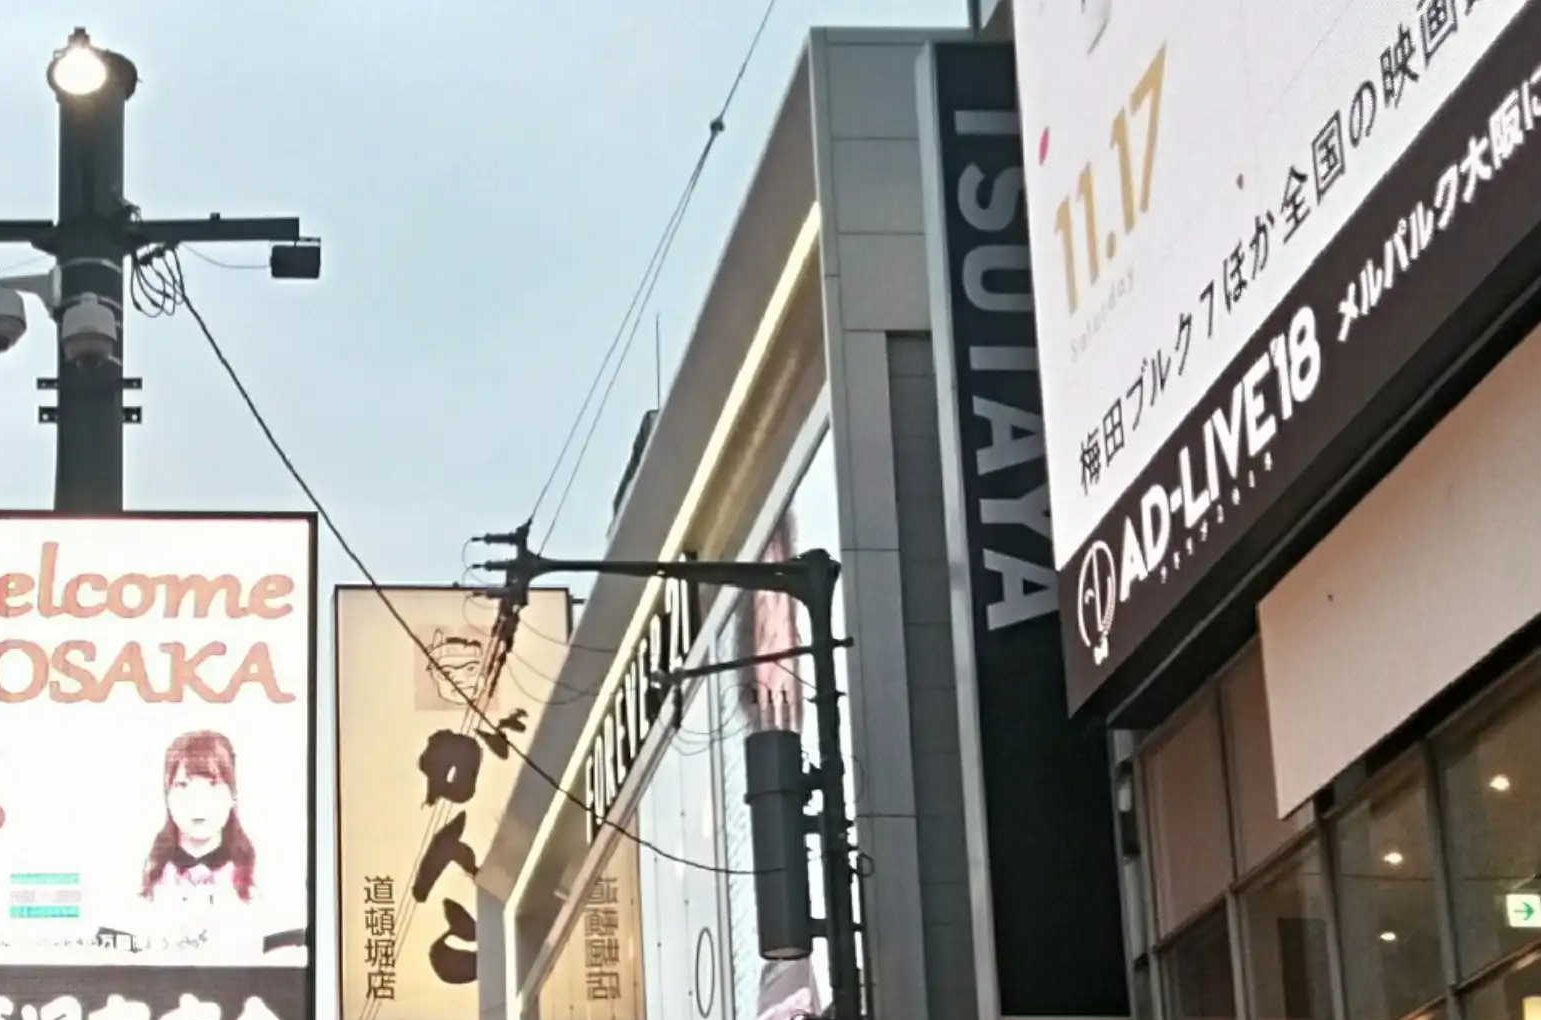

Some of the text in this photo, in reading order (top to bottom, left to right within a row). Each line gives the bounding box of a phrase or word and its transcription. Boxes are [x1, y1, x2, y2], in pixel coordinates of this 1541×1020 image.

[1054, 40, 1167, 316] 11.17
[1079, 0, 1476, 497] 梅田ブルク7ほか全国の映画
[363, 876, 396, 1001] 道頓堀店
